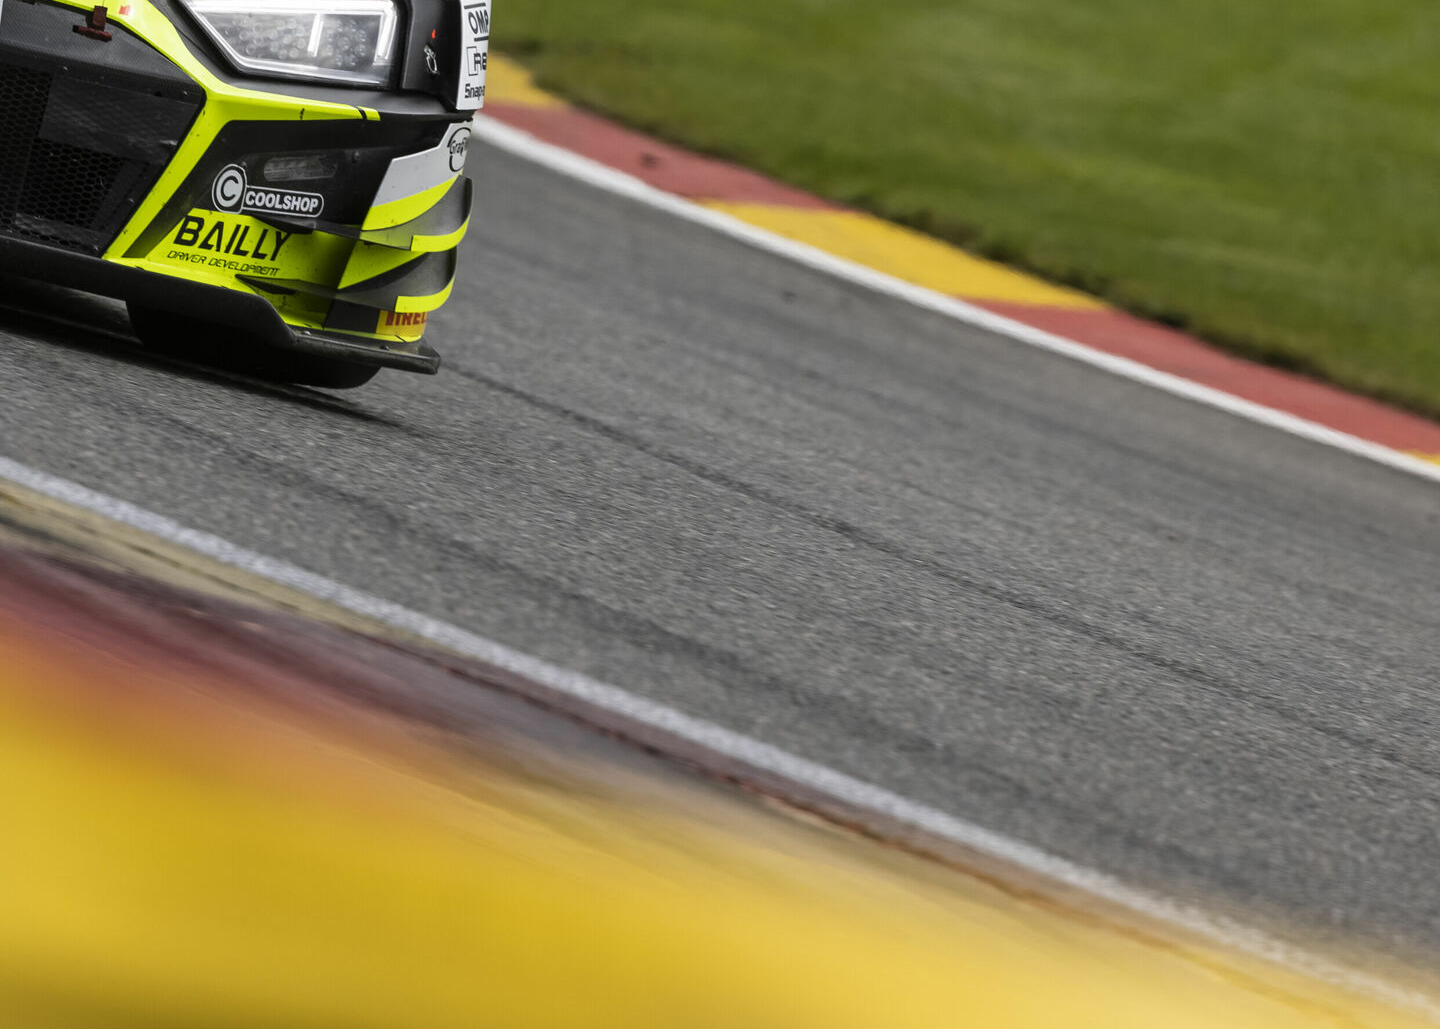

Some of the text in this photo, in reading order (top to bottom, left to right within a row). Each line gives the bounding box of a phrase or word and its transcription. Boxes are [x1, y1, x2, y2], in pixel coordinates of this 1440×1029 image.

[245, 189, 320, 213] COOLSHOP
[173, 214, 293, 262] BAILLY
[167, 250, 281, 277] DRIVER DEVELOPMENT
